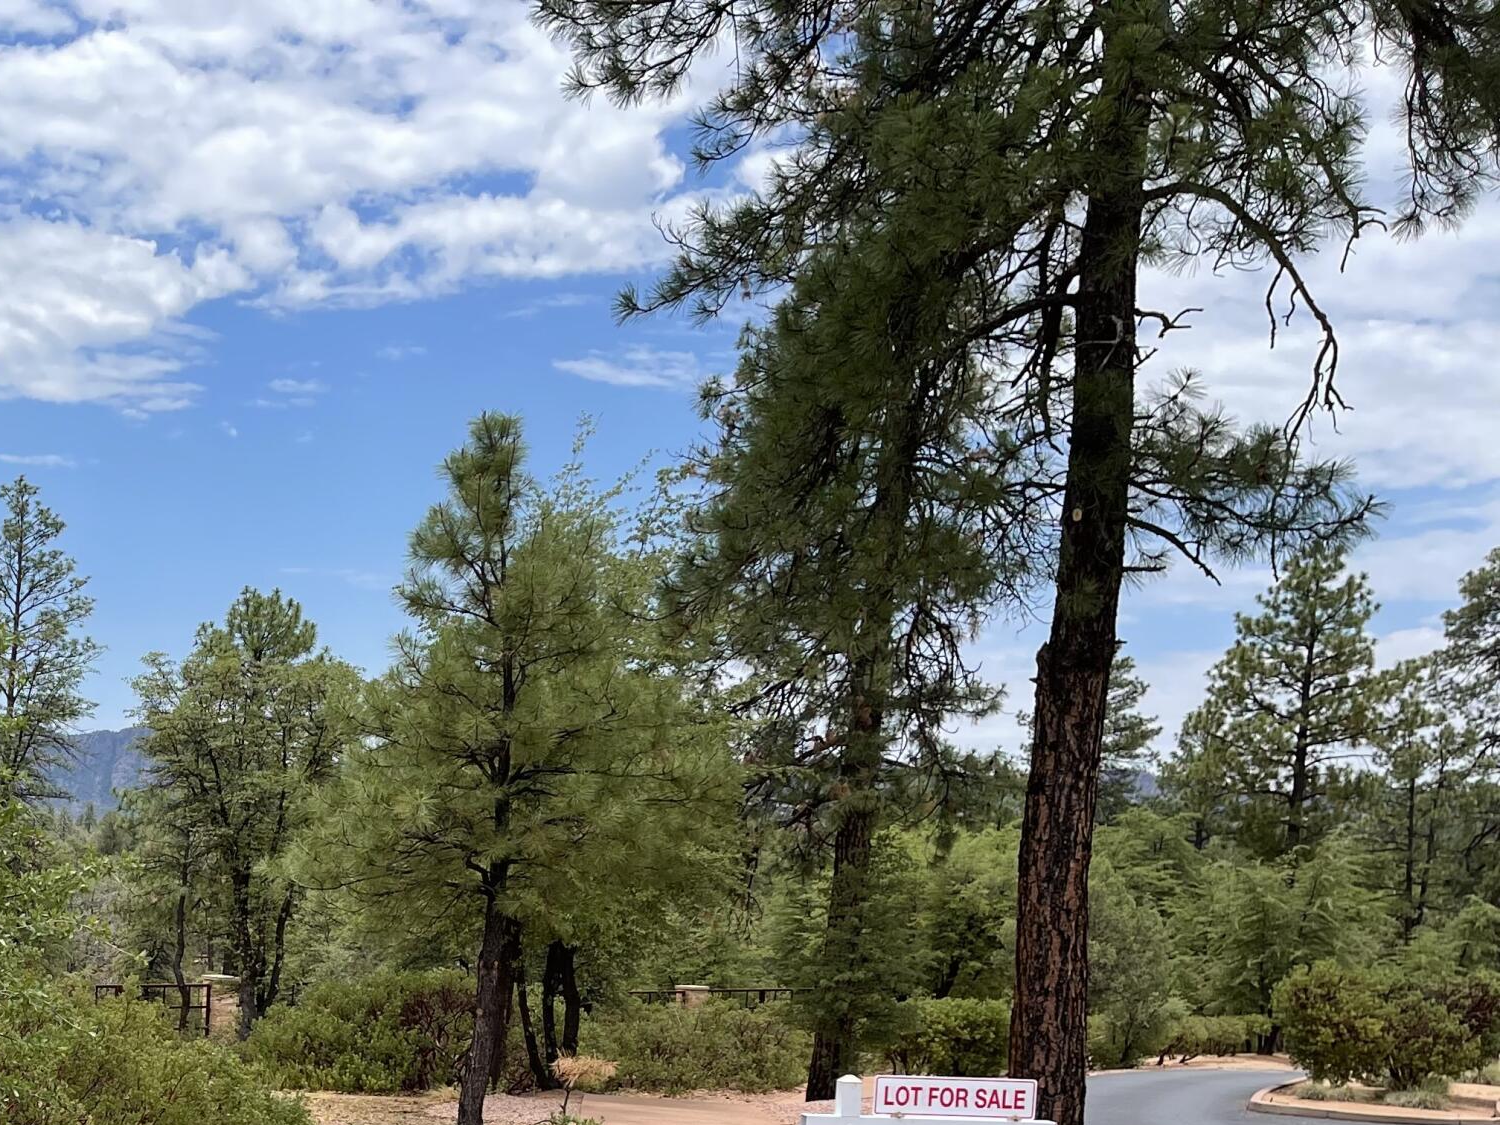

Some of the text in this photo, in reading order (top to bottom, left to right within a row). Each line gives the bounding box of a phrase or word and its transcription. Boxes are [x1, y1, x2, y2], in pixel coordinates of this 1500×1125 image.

[883, 1085, 1027, 1110] LOT FOR SALE
